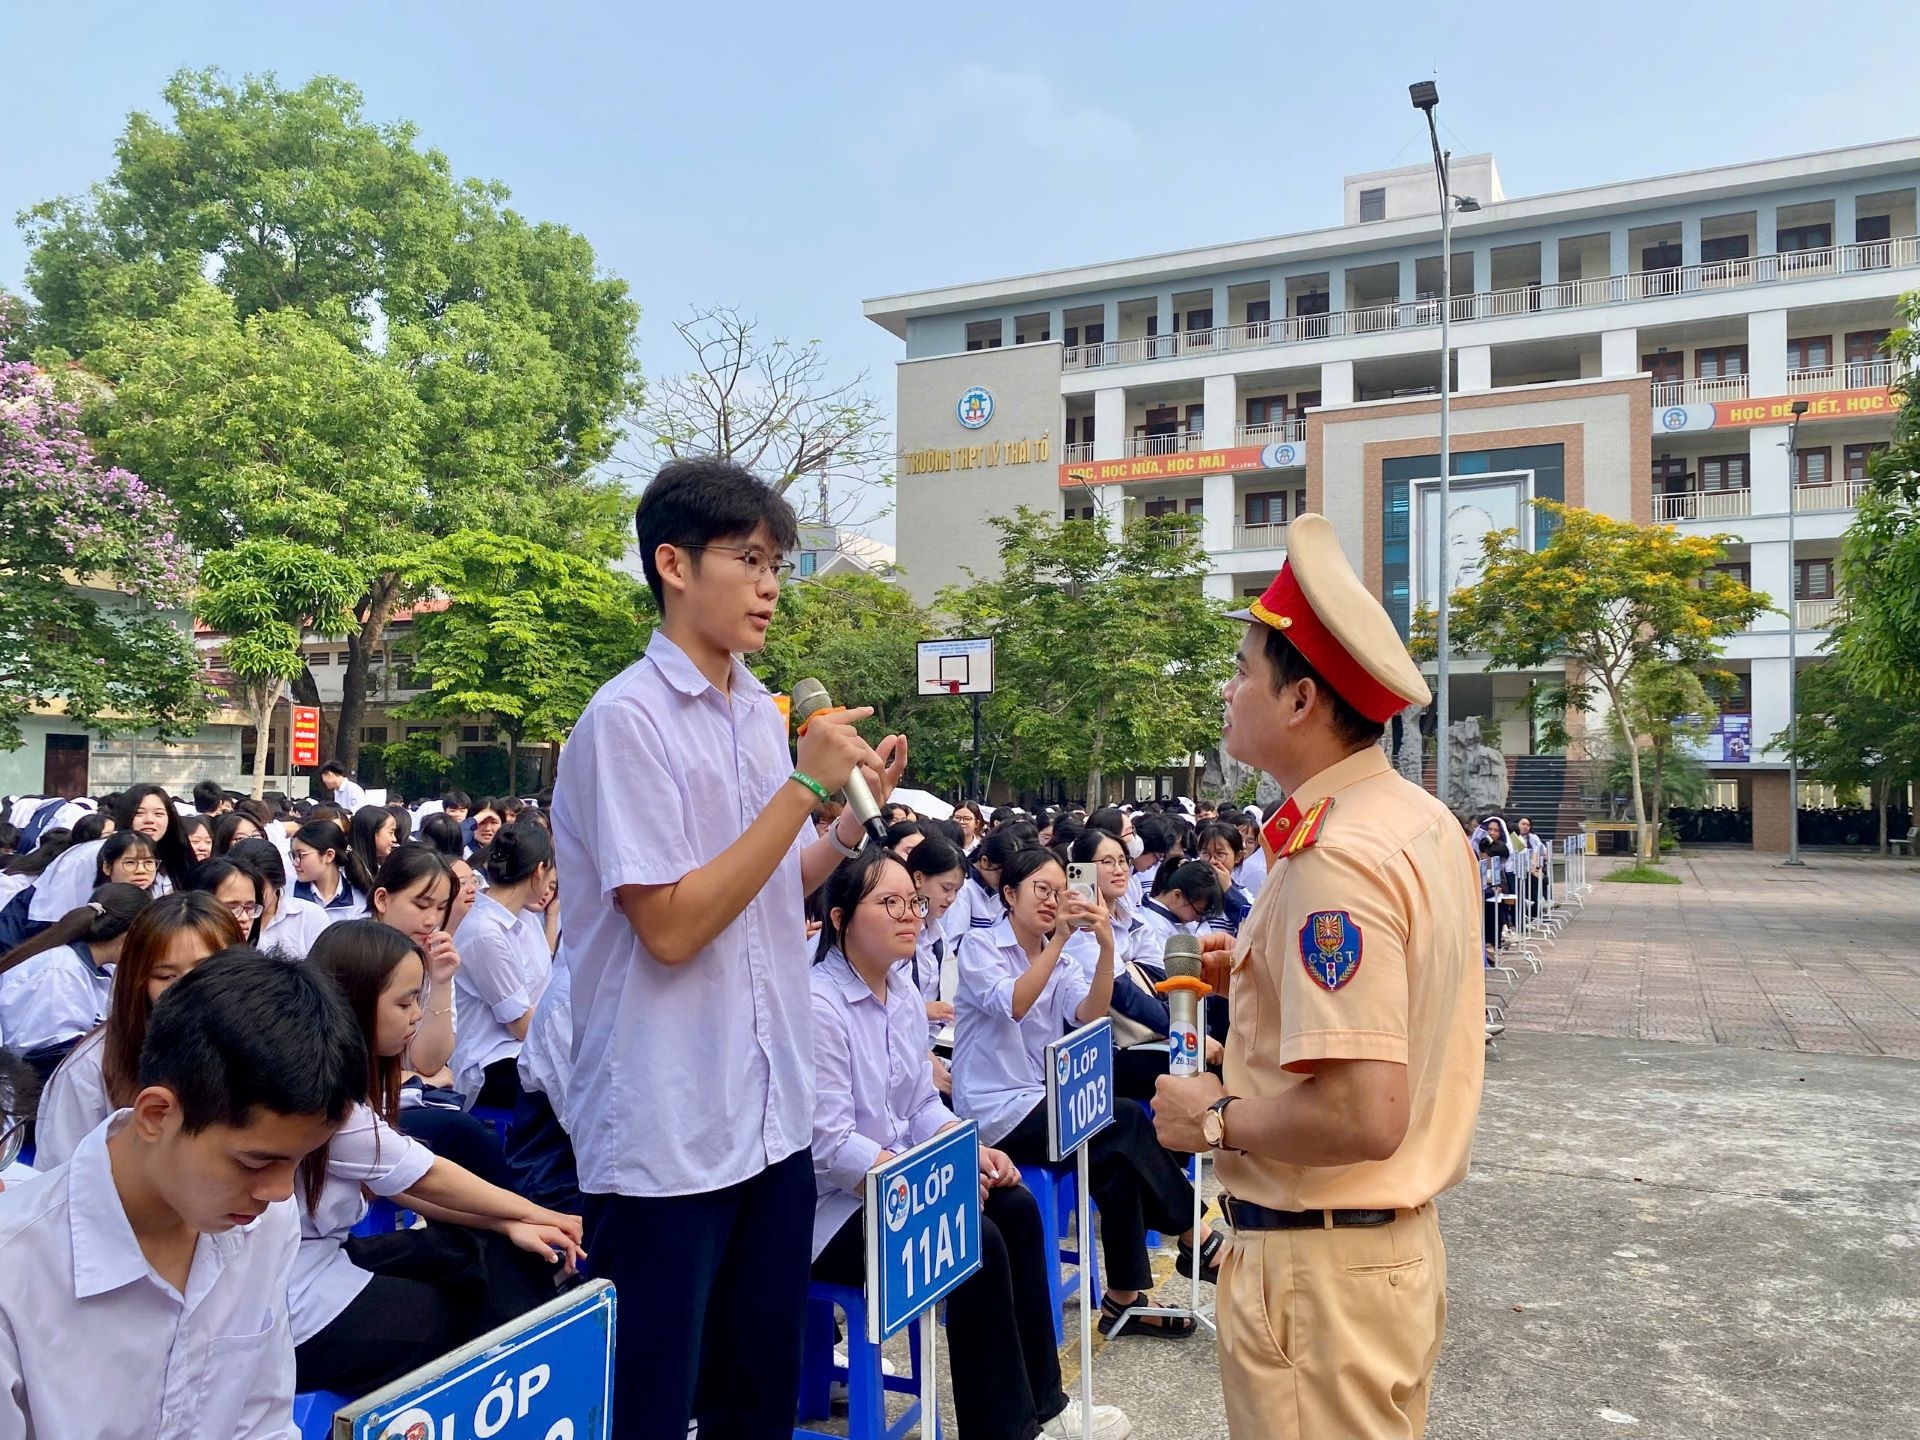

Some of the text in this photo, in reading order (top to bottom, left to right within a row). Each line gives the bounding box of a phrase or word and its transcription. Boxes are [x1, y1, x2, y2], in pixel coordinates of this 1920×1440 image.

[1731, 407, 1765, 422] HỌC
[1803, 397, 1841, 415] IẾT,
[1846, 396, 1883, 413] HỌC
[954, 447, 983, 470] THPT
[986, 440, 999, 466] LÝ
[1004, 437, 1030, 465] THÁI
[1102, 465, 1127, 480] HỌC
[1167, 458, 1194, 474] HỌC
[1199, 454, 1226, 470] MÃI
[1074, 1045, 1098, 1080] LỚP
[1069, 1075, 1106, 1135] 10D3
[912, 1162, 954, 1216] LỚP
[902, 1203, 966, 1299] 11A1
